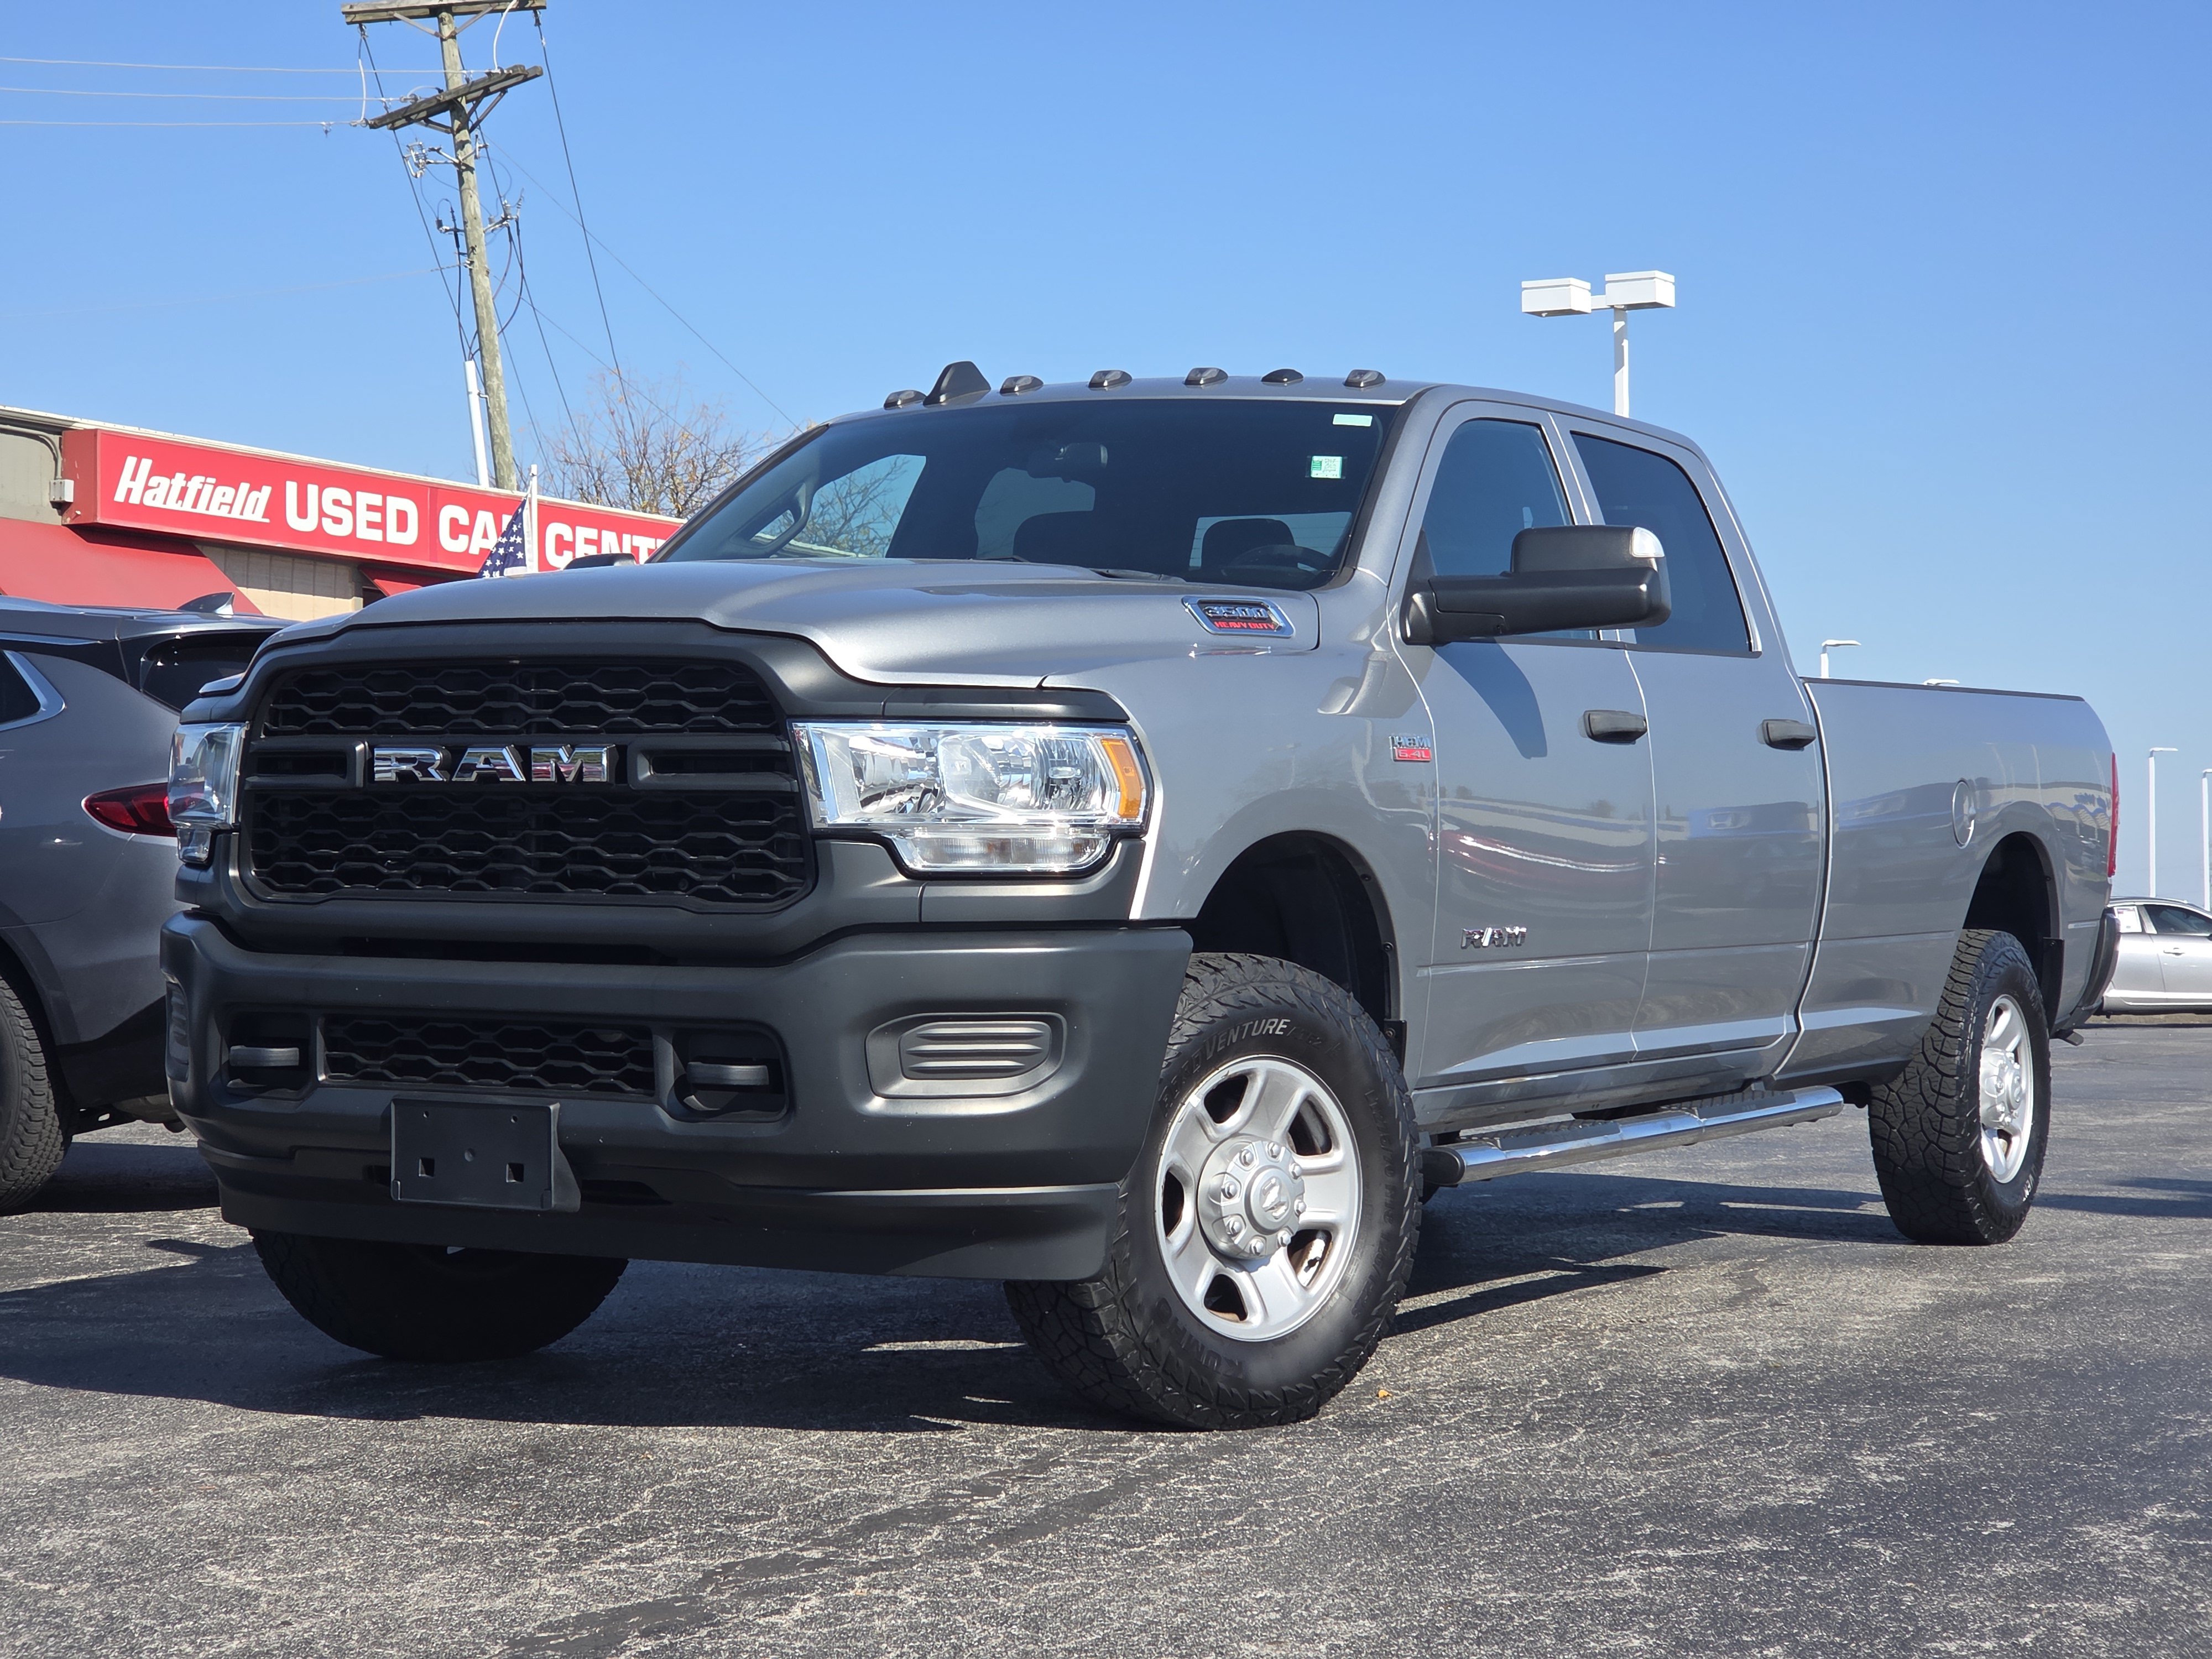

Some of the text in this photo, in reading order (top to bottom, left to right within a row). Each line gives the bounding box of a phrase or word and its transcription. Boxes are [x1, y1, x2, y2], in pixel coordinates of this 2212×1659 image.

[114, 456, 667, 571] Hatfield USED CA CENT
[373, 743, 616, 783] RAM
[1398, 749, 1430, 759] 6.4L
[1460, 926, 1527, 950] RAM
